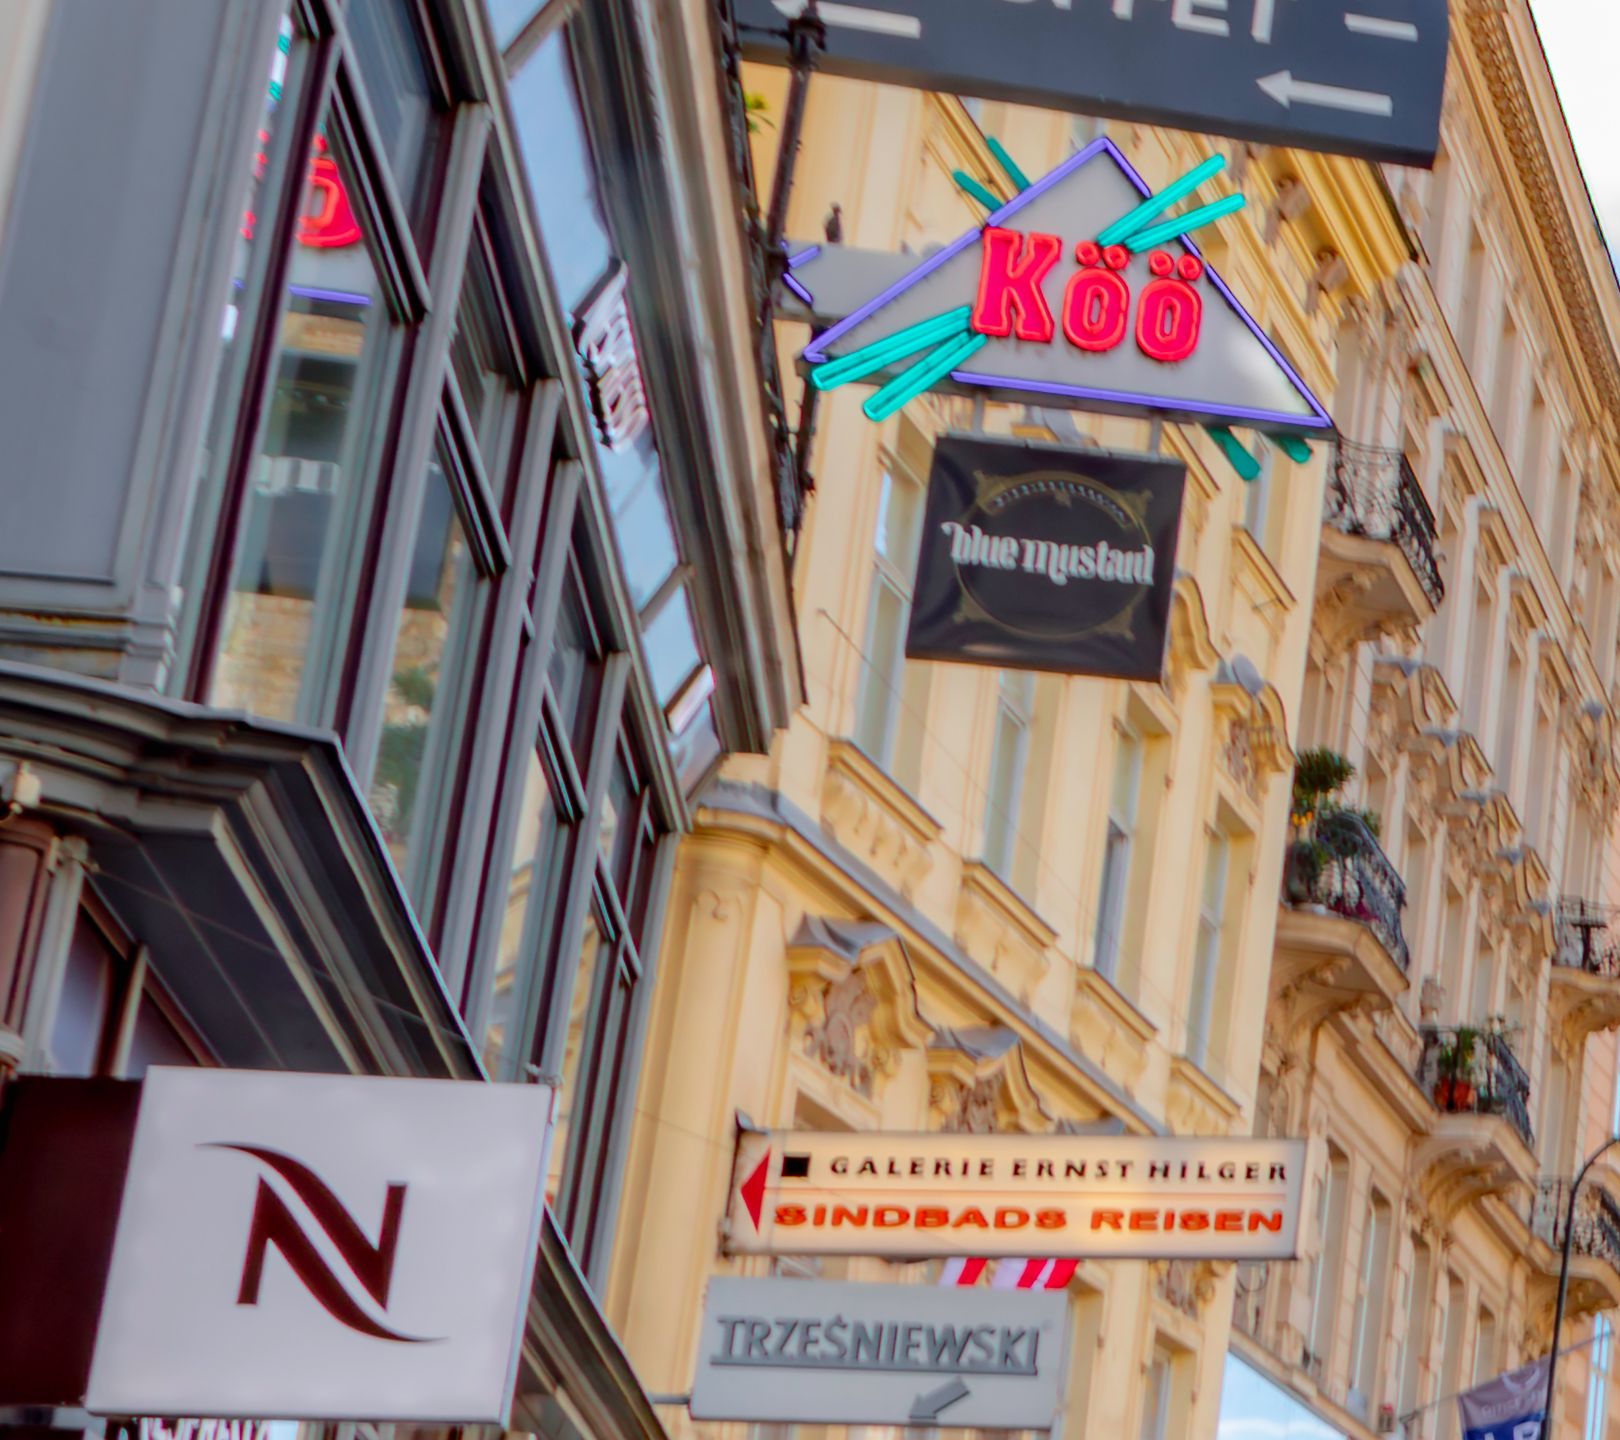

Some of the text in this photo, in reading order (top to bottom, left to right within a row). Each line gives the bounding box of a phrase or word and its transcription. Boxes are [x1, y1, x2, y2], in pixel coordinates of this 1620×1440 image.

[971, 226, 1202, 361] Köö
[941, 521, 1019, 571] blue
[831, 1156, 1288, 1181] GALERIE ERNST HILGER
[773, 1205, 1283, 1233] SINDBADS REISEN
[717, 1312, 1041, 1368] TRZEŚNIEWSKI
